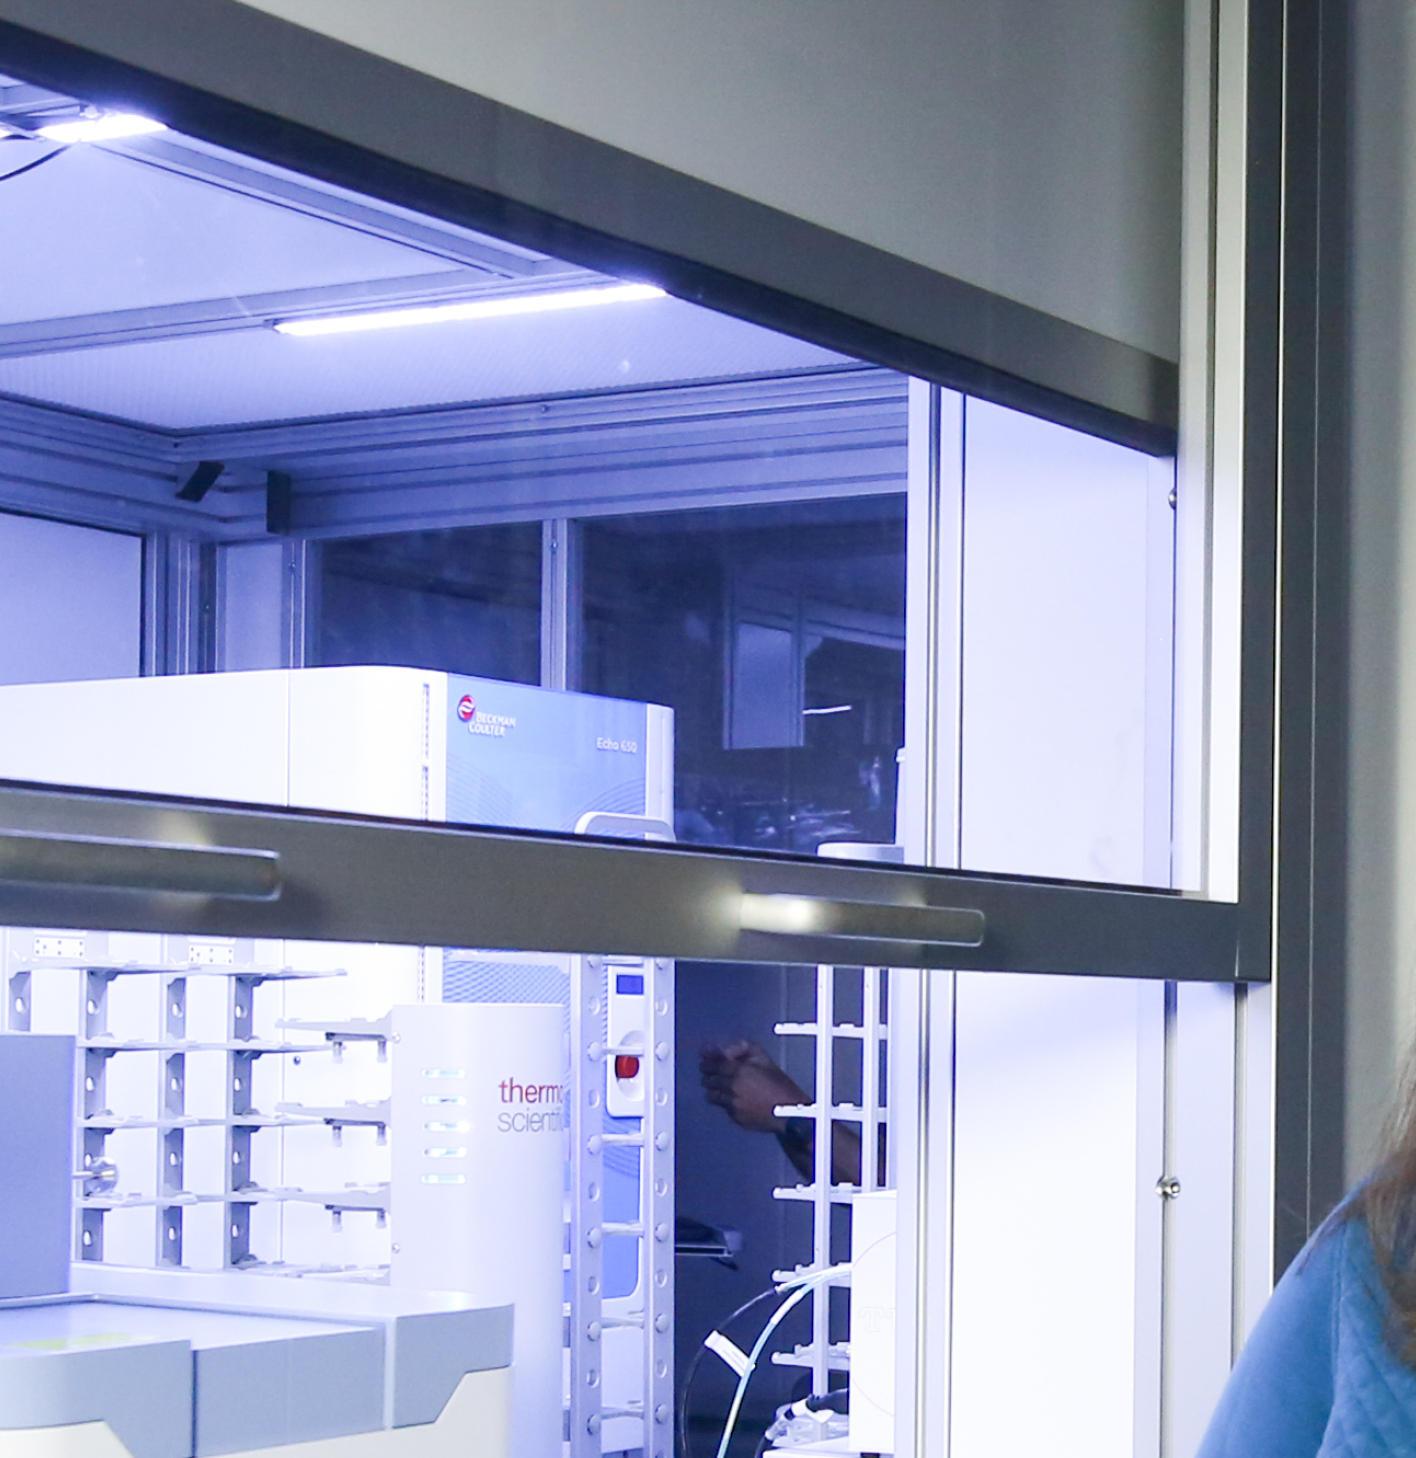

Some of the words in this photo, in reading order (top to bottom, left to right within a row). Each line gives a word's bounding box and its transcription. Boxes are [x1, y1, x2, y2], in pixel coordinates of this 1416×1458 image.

[476, 712, 517, 727] BECKMAN
[468, 721, 506, 736] COULTER
[596, 737, 619, 751] Echo
[620, 739, 638, 754] 650
